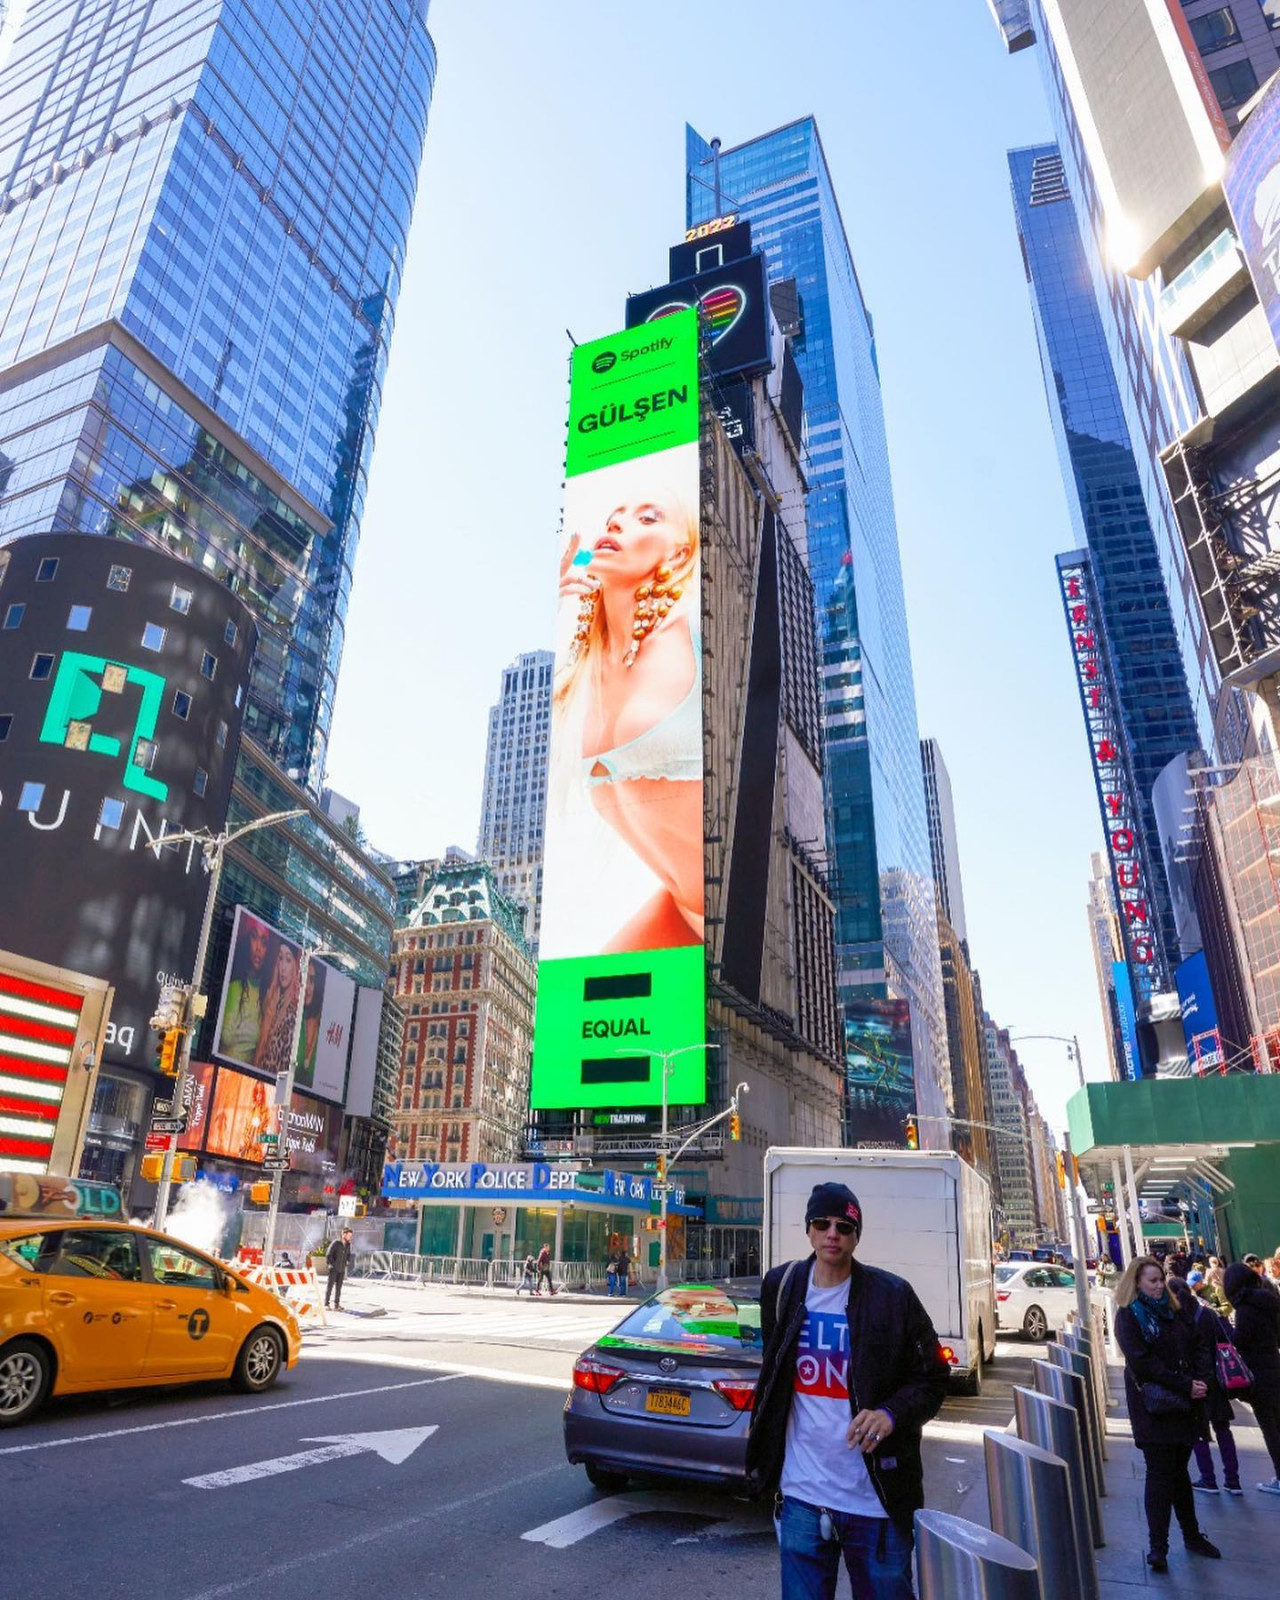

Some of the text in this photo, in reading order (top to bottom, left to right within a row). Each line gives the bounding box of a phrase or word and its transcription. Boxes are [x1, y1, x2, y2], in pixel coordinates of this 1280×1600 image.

[685, 215, 736, 242] 2022
[620, 337, 674, 363] Spotify
[578, 384, 688, 434] GÜLŞEN
[1066, 578, 1153, 963] ERNST & YOUNG
[582, 1017, 651, 1039] EQUAL
[384, 1163, 579, 1190] NEW YORK POLICE DEPT
[796, 1354, 848, 1391] ON
